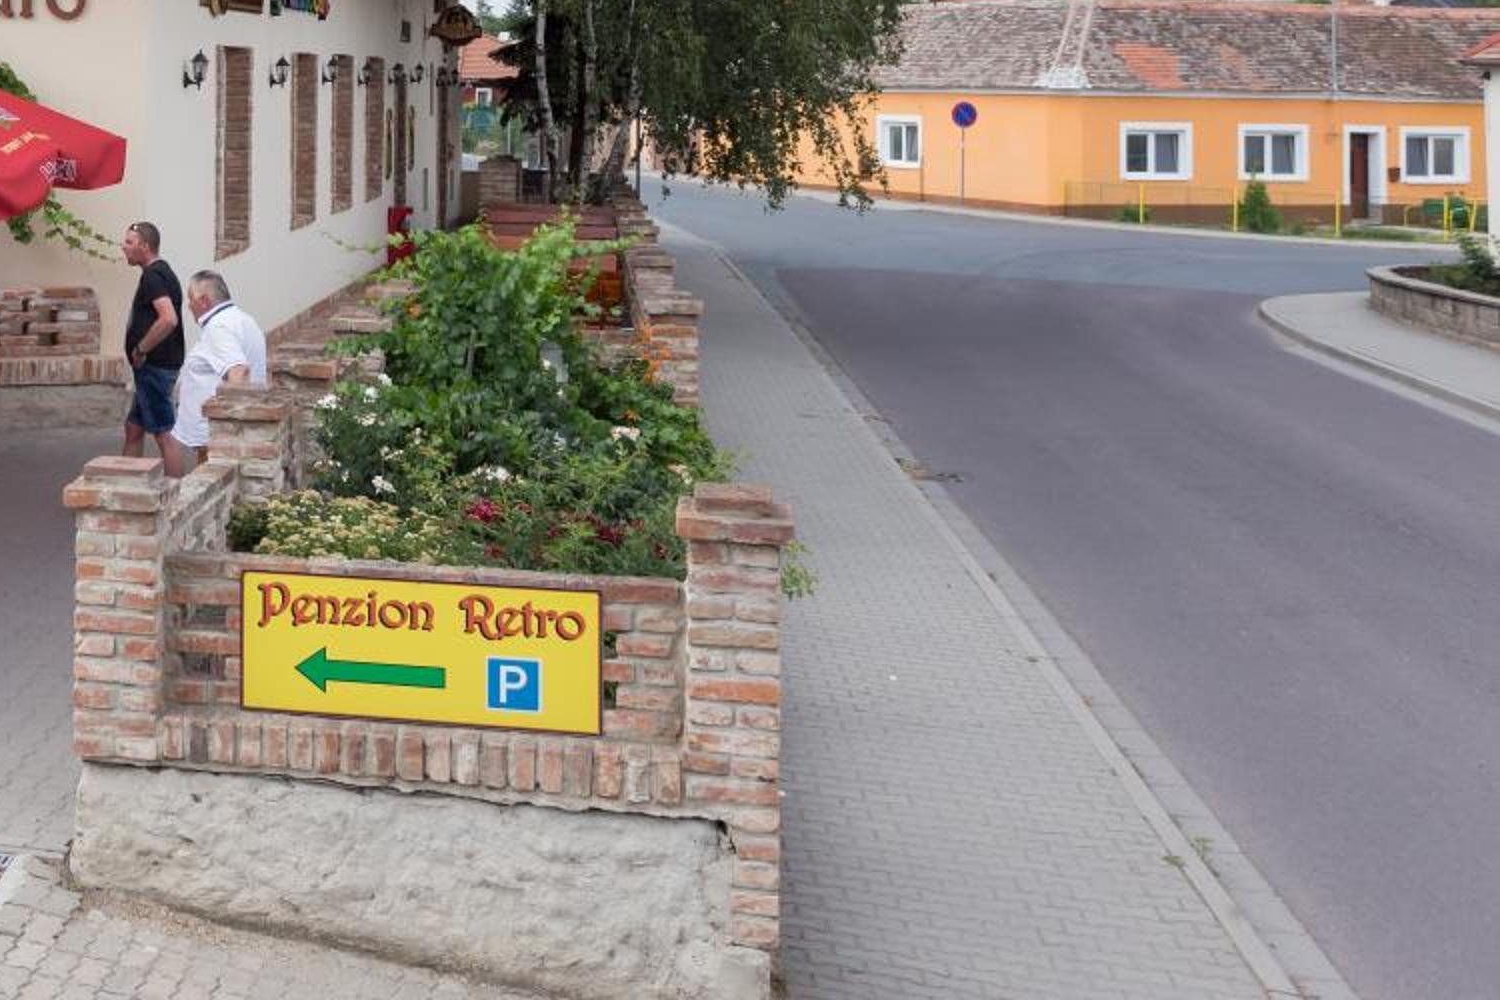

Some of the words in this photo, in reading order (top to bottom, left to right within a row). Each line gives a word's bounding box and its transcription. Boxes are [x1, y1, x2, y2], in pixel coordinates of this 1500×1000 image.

[257, 581, 436, 633] Penzion
[458, 594, 587, 642] Retro
[498, 664, 529, 704] P
